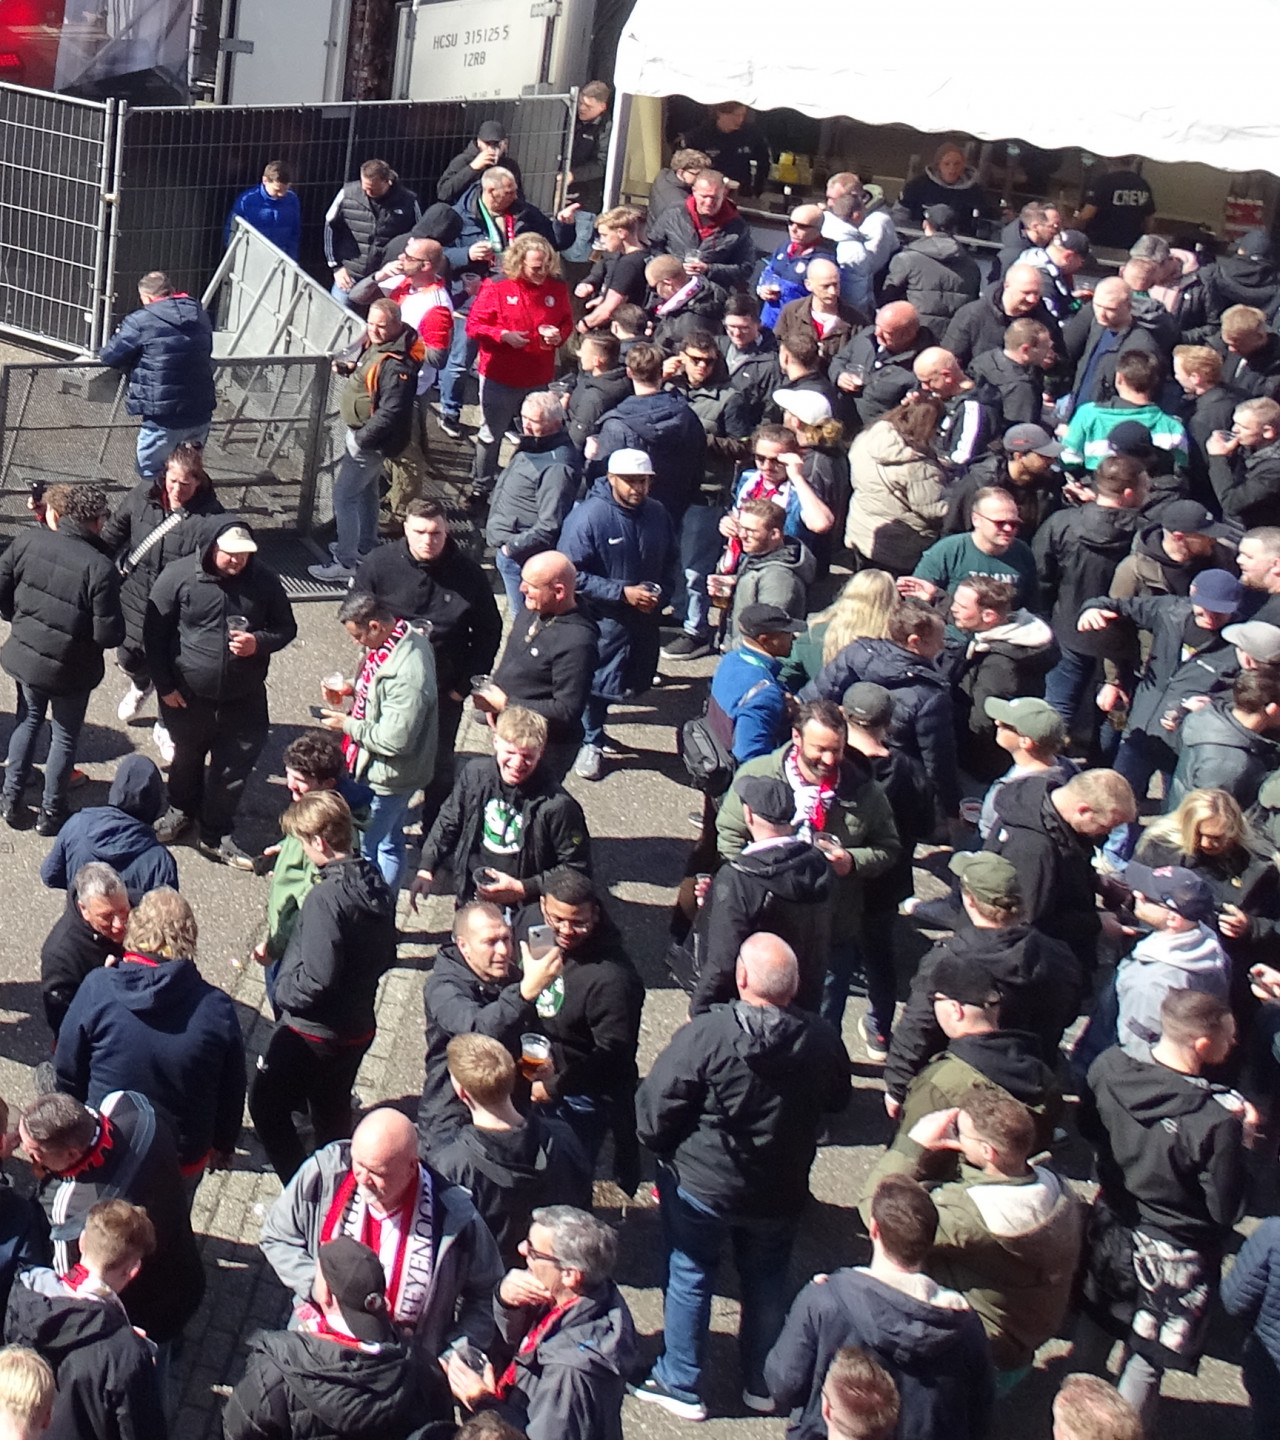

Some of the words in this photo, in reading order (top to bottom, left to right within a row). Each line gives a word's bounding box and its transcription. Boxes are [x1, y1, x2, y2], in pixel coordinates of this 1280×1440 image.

[432, 32, 458, 50] HCSU
[463, 26, 501, 45] 315125
[462, 51, 487, 67] 12RB
